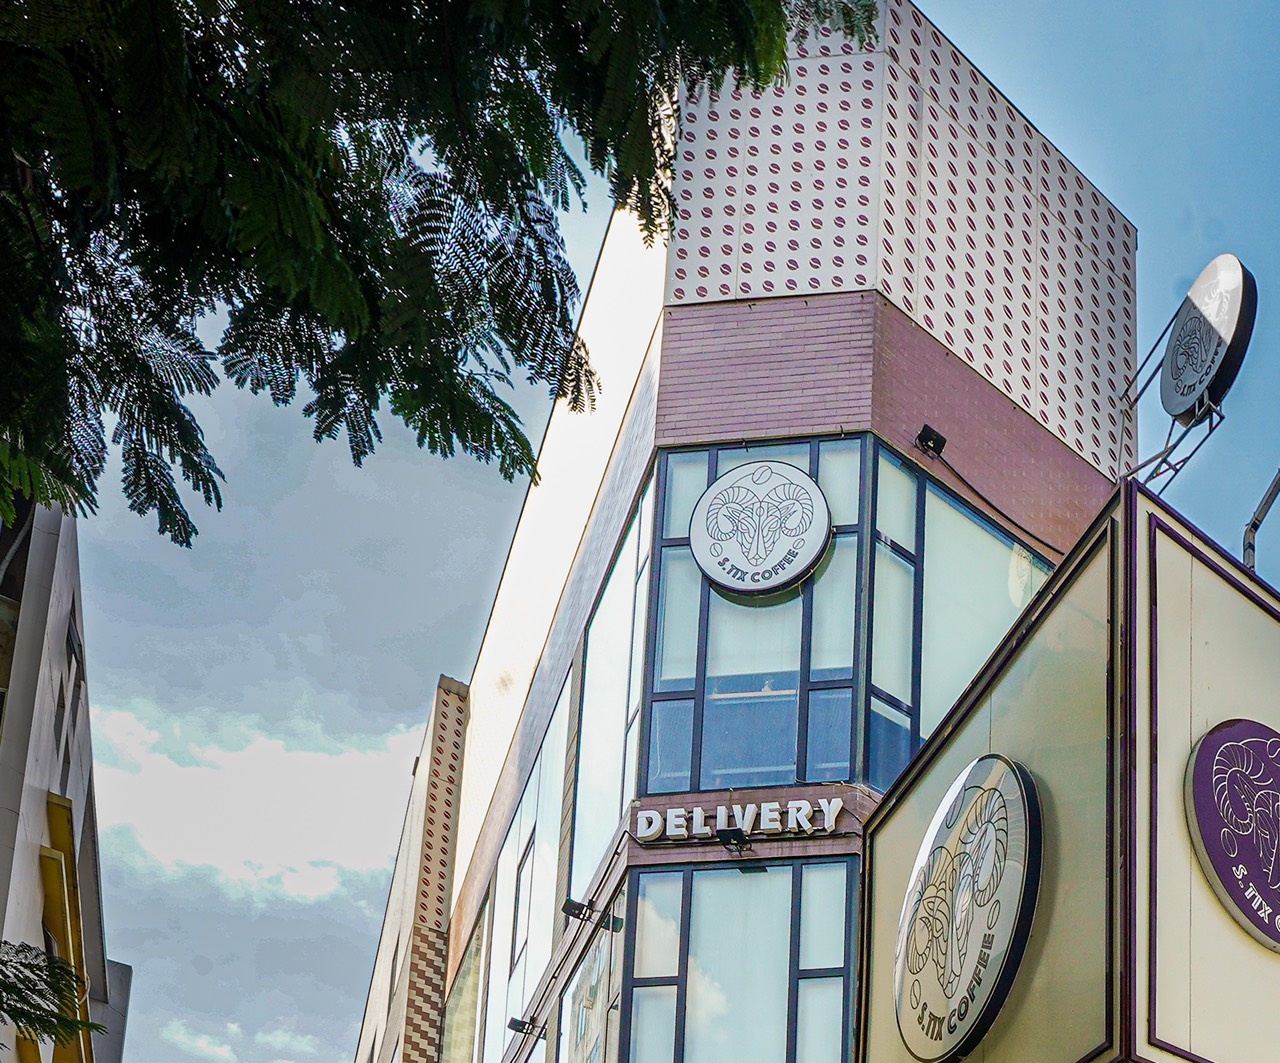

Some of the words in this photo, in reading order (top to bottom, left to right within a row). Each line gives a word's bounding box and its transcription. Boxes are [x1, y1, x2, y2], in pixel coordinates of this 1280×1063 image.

[750, 547, 800, 583] COFFEE
[637, 798, 844, 842] DELIVERY
[947, 933, 995, 1033] COFFEE
